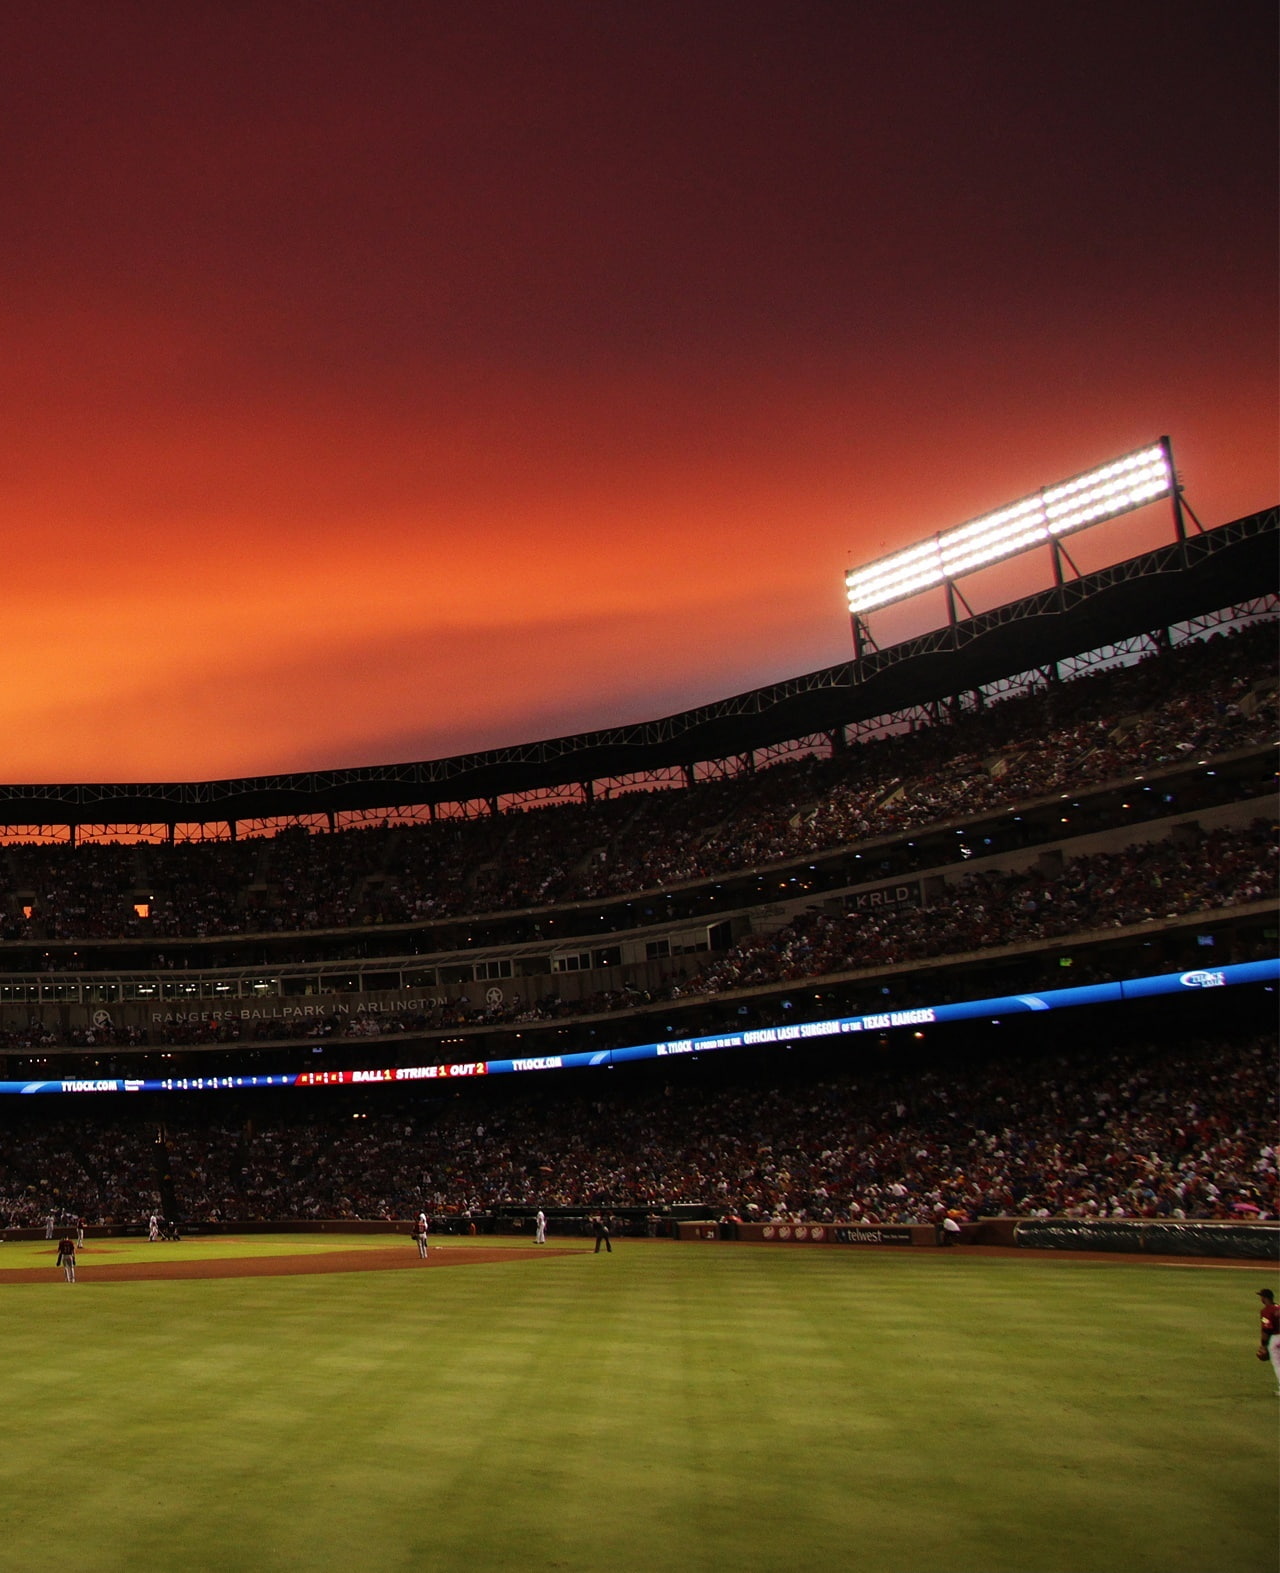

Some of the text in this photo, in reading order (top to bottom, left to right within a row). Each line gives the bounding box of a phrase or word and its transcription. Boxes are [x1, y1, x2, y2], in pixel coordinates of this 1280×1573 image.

[856, 887, 909, 908] KRLD
[152, 996, 448, 1023] RANGERS BALLPARK IN ARLINGTON
[668, 1040, 693, 1054] TYLOCK
[743, 1029, 778, 1045] OFFICIAL
[777, 1026, 801, 1040] LASIK
[800, 1020, 841, 1038] SURGEON
[862, 1014, 891, 1030] TEXAS
[891, 1008, 935, 1026] RANGERS
[352, 1071, 384, 1082] BALL
[384, 1069, 392, 1080] 1
[396, 1066, 438, 1080] STRIKE
[438, 1065, 447, 1076] 1
[450, 1063, 475, 1075] OUT
[476, 1062, 484, 1074] 2
[512, 1056, 562, 1071] TYLOCK.COM
[61, 1081, 118, 1092] TYLOCK.COM
[847, 1228, 882, 1242] telwest
